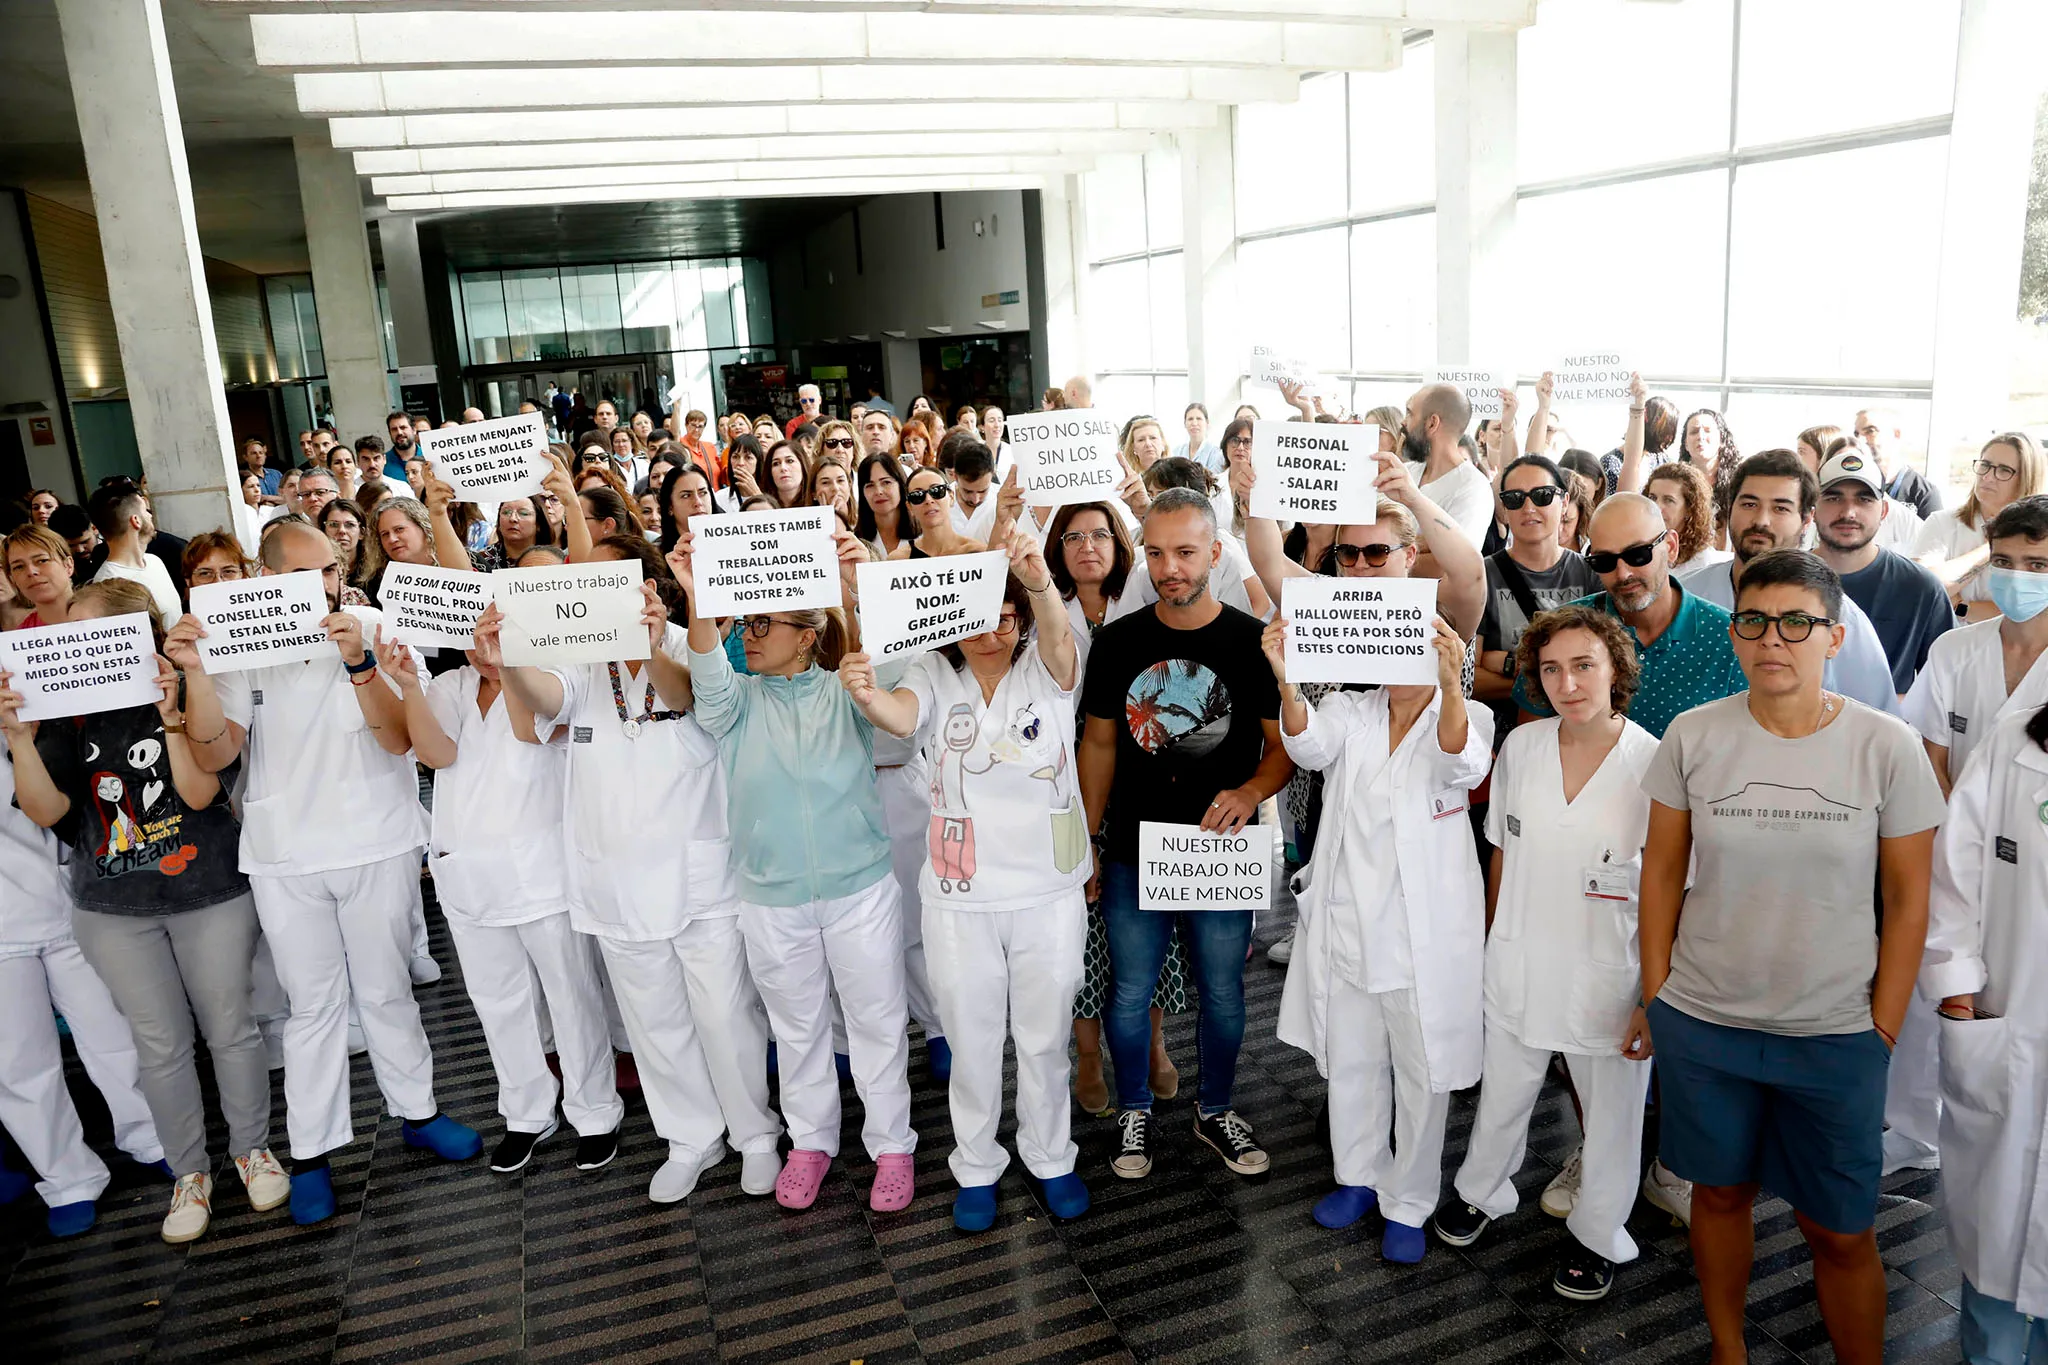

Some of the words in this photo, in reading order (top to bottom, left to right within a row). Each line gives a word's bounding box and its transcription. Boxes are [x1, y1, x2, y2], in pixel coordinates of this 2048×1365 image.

[1565, 354, 1620, 367] NUESTRO
[1437, 372, 1490, 382] NUESTRO
[1556, 372, 1608, 384] TRABAJO
[1611, 371, 1630, 382] NO
[1481, 388, 1498, 398] NO
[1554, 389, 1582, 400] VALE
[1586, 388, 1632, 399] MENOS
[430, 434, 477, 450] PORTEM
[480, 424, 536, 440] MENJANT-
[1013, 425, 1050, 443] ESTO
[1055, 422, 1080, 438] NO
[1084, 421, 1112, 436] SALE
[440, 452, 465, 464] NOS
[468, 448, 486, 458] LES
[489, 439, 534, 455] MOLLES
[1277, 436, 1350, 452] PERSONAL
[1038, 448, 1064, 465] SIN
[1070, 446, 1098, 462] LOS
[1277, 456, 1346, 472] LABORAL:
[452, 466, 472, 476] DES
[475, 462, 496, 472] DEL
[498, 456, 527, 468] 2014.
[461, 474, 511, 488] CONVENI
[514, 469, 528, 482] JA!
[1028, 470, 1113, 491] LABORALES
[1287, 477, 1338, 491] SALARI
[1290, 497, 1338, 512] HORES
[704, 523, 776, 538] NOSALTRES
[779, 517, 822, 532] TAMBÉ
[750, 540, 778, 551] SOM
[718, 553, 814, 570] TREBALLADORS
[395, 575, 412, 584] NO
[414, 577, 440, 588] SOM
[441, 580, 482, 594] EQUIPS
[508, 580, 572, 596] ¡Nuestro
[578, 574, 629, 590] trabajo
[708, 574, 763, 586] PÚBLICS,
[766, 570, 810, 582] VOLEM
[813, 568, 826, 578] EL
[890, 572, 932, 591] AIXÒ
[936, 569, 954, 586] TÉ
[960, 568, 983, 582] UN
[229, 588, 284, 604] SENYOR
[386, 590, 400, 600] DE
[403, 592, 450, 608] FUTBOL,
[452, 598, 484, 611] PROU
[734, 588, 782, 601] NOSTRE
[786, 587, 804, 598] 2%
[916, 593, 960, 610] NOM:
[1332, 591, 1384, 602] ARRIBA
[1500, 588, 1580, 600] MILYN
[207, 606, 287, 624] CONSELLER,
[290, 602, 312, 614] ON
[401, 606, 416, 616] DE
[418, 609, 470, 622] PRIMERA
[556, 602, 587, 620] NO
[908, 608, 966, 631] GREUGE
[1295, 609, 1382, 622] HALLOWEEN,
[1386, 606, 1422, 620] PERÒ
[229, 625, 272, 638] ESTAN
[276, 621, 298, 632] ELS
[396, 618, 444, 632] SEGONA
[446, 626, 475, 636] DIVIS
[1296, 626, 1308, 636] EL
[1312, 627, 1340, 639] QUE
[1343, 628, 1360, 638] FA
[1364, 628, 1391, 638] POR
[1394, 624, 1424, 638] SÓN
[12, 637, 54, 652] LLEGA
[57, 625, 141, 646] HALLOWEEN,
[208, 640, 269, 656] NOSTRES
[272, 633, 326, 649] DINERS?
[530, 634, 560, 647] vale
[564, 628, 618, 644] menos!
[884, 619, 986, 654] COMPARATIU!
[27, 651, 61, 664] PERO
[65, 648, 82, 660] LO
[86, 644, 112, 657] QUE
[115, 641, 133, 652] DA
[1298, 643, 1334, 654] ESTES
[1337, 644, 1424, 656] CONDICIONS
[25, 666, 68, 680] MIEDO
[72, 662, 100, 674] SON
[104, 655, 140, 668] ESTAS
[42, 672, 132, 692] CONDICIONES
[1712, 808, 1752, 817] WALKING
[1757, 809, 1768, 818] TO
[1772, 810, 1790, 818] OUR
[1794, 810, 1850, 822] EXPANSION
[143, 820, 164, 834] You
[167, 814, 182, 826] are
[148, 827, 170, 843] such
[172, 826, 180, 834] a
[1162, 836, 1248, 853] NUESTRO
[1147, 861, 1228, 878] TRABAJO
[1234, 862, 1262, 876] NO
[1146, 886, 1190, 900] VALE
[1196, 886, 1264, 901] MENOS
